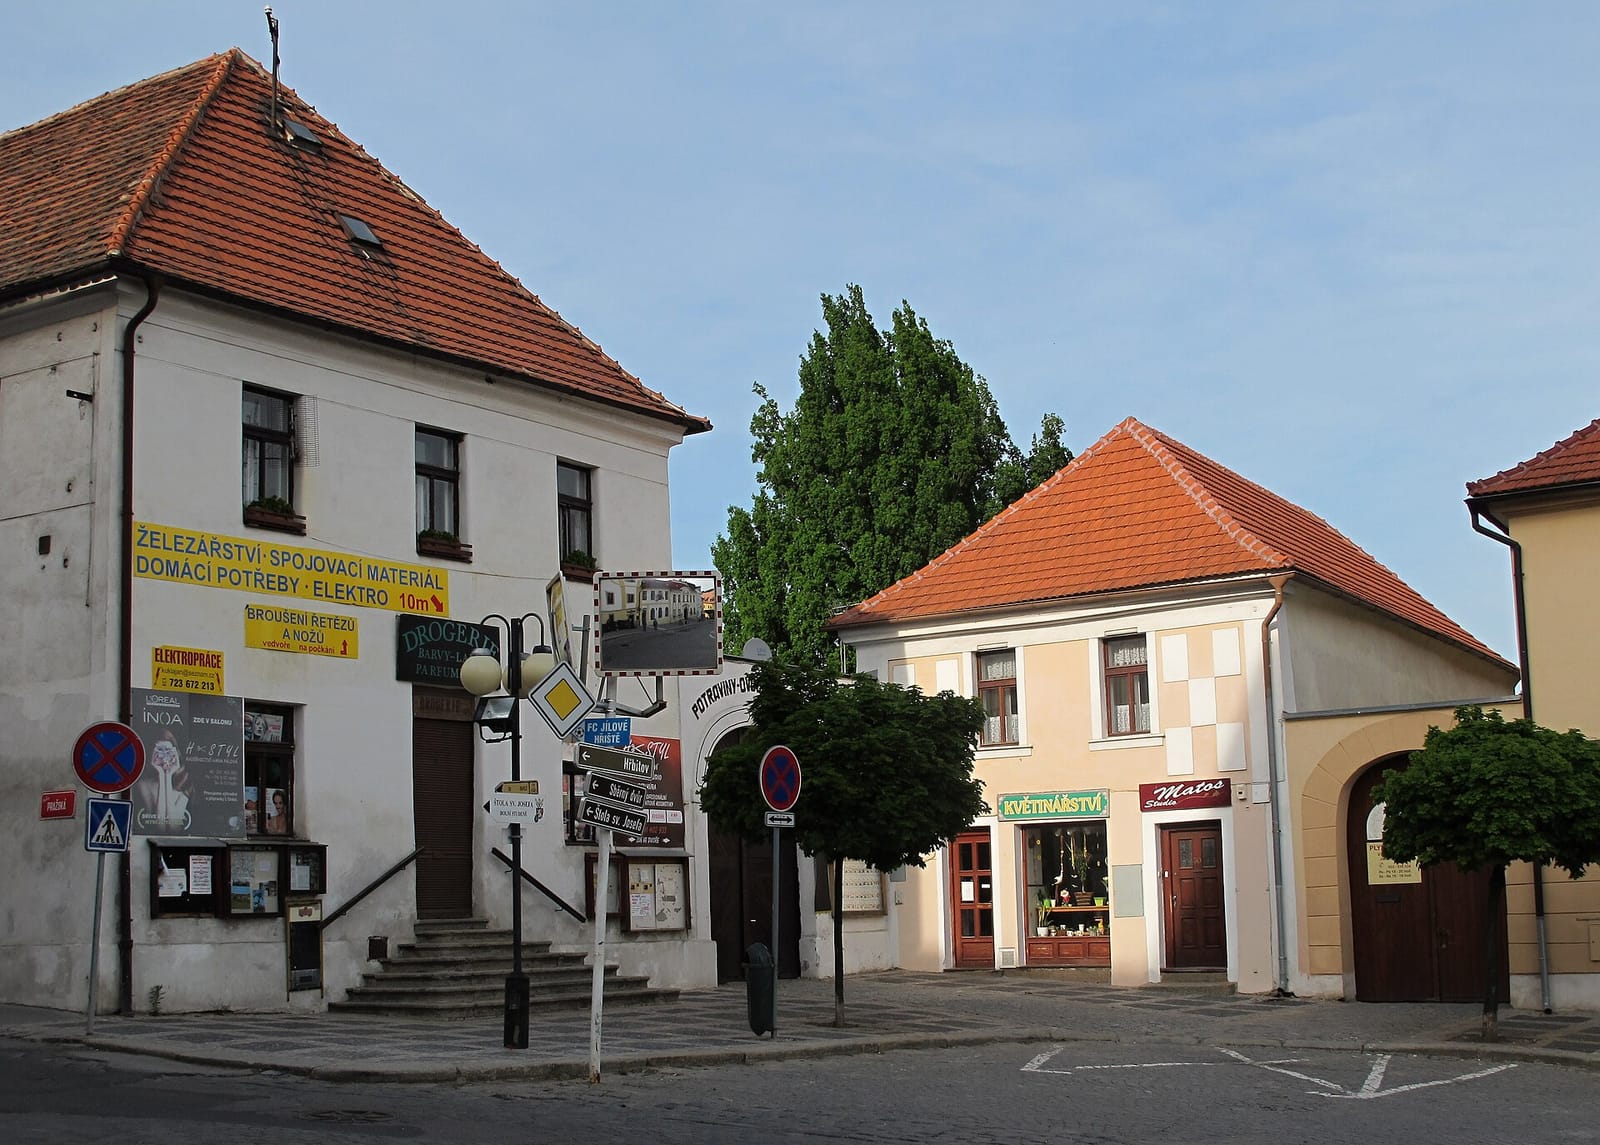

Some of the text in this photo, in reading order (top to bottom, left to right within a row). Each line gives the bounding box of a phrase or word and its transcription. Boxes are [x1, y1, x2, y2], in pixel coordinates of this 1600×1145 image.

[137, 524, 444, 590] ŽELEZÁŘSTVÍ SPOJOVACÍ MATERIÁL
[136, 555, 428, 611] DOMÁCÍ POTŘEBY ELEKTRO 10m
[247, 607, 355, 631] BROUŠENÍ ŘETĚZŮ
[283, 628, 290, 640] A
[155, 647, 221, 669] ELEKTROPRÁCE
[170, 678, 215, 691] 723 672 213
[691, 678, 736, 720] POTRAVINY
[587, 719, 628, 732] FC JÍLOVÉ
[594, 732, 621, 744] HŘIŠTĚ
[623, 756, 650, 774] Hřbitov
[609, 783, 629, 802] Sběrný
[630, 790, 643, 805] dvůr
[1153, 780, 1225, 800] Matos
[1003, 792, 1102, 815] KVĚTINÁŘSTVÍ
[1143, 799, 1177, 808] Studio
[594, 804, 610, 823] Štola
[612, 815, 620, 826] sv.
[622, 817, 643, 831] Josefa
